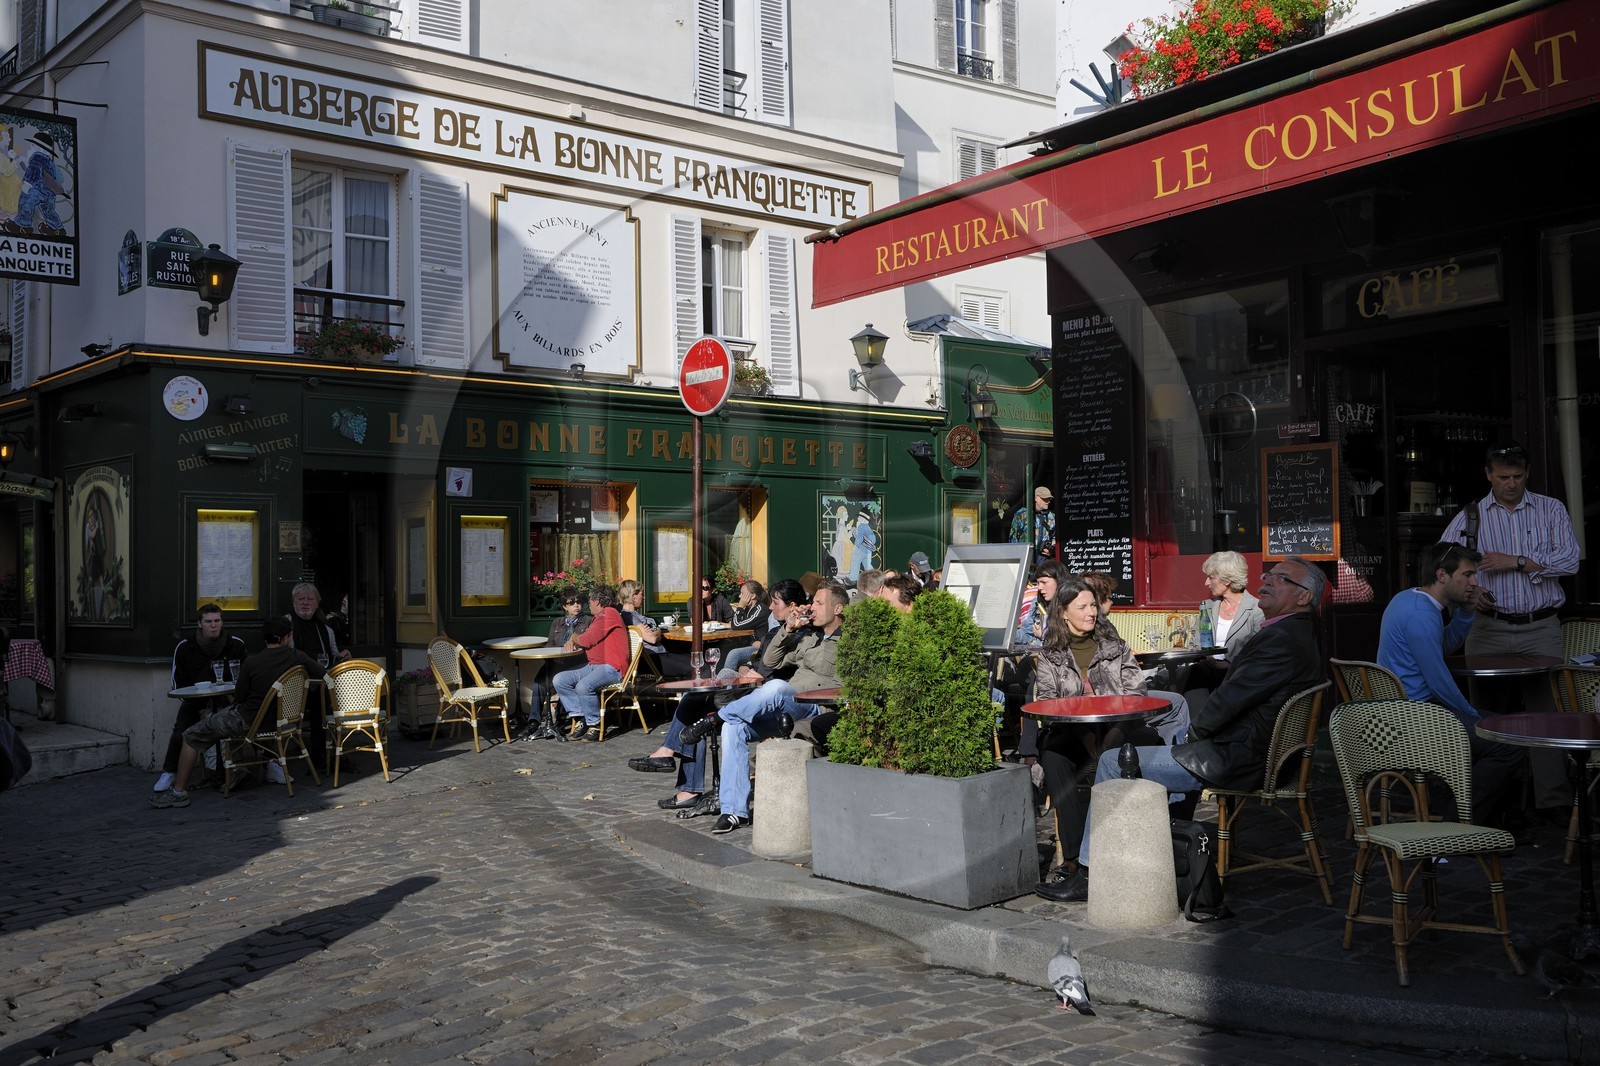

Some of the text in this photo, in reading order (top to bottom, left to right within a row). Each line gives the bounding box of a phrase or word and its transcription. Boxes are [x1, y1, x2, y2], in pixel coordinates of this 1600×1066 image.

[1152, 30, 1577, 200] LE CONSULAT
[230, 68, 856, 219] AUBERGE DE LA BONNE FRANQUETTE
[528, 217, 608, 246] ANCIENNEMENT
[876, 198, 1050, 276] RESTAURANT
[17, 242, 72, 259] BONNE
[171, 251, 190, 262] RUE
[166, 262, 190, 272] SAIN
[1356, 256, 1460, 319] CAFÉ
[1062, 318, 1083, 332] MENU
[1085, 317, 1090, 327] à
[1081, 330, 1090, 338] plat
[1095, 326, 1114, 334] dessert
[533, 334, 585, 357] BILLARDS
[589, 341, 603, 354] EN
[389, 412, 868, 470] LA BONNE FRANQUETTE
[176, 454, 214, 472] BOIR
[1082, 452, 1105, 462] ENTRÉES
[1087, 529, 1103, 537] PLATS
[1346, 566, 1374, 576] OUVERT
